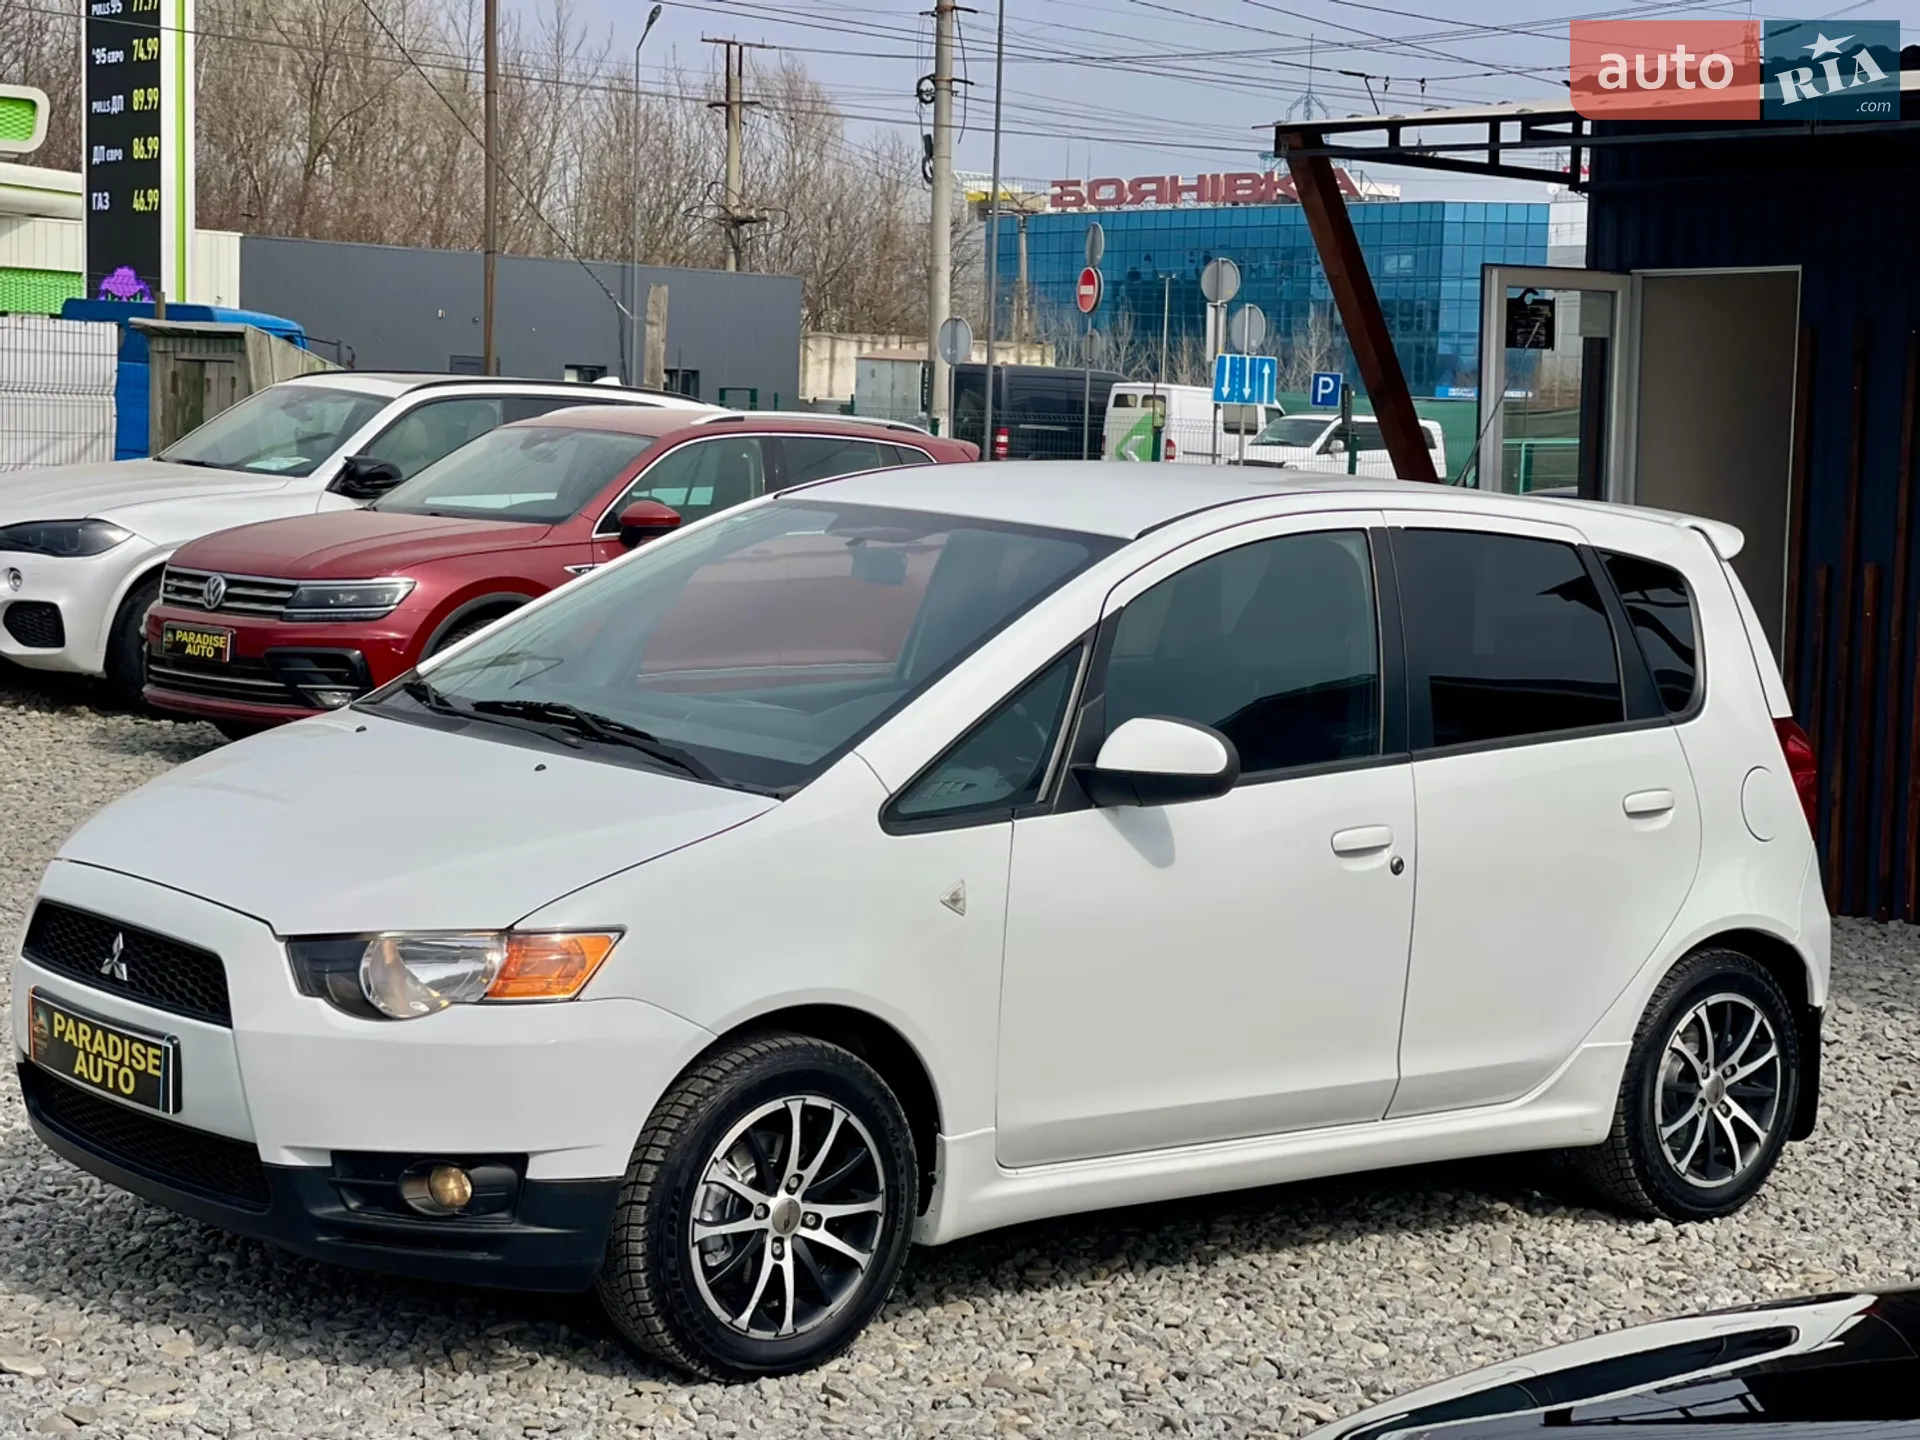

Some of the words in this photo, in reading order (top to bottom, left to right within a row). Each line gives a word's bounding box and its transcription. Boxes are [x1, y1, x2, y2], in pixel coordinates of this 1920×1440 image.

[132, 37, 158, 61] 74.99
[133, 88, 158, 111] 89.99
[92, 145, 105, 164] ДП
[133, 136, 158, 159] 86.99
[92, 191, 110, 210] ГАЗ
[132, 189, 158, 211] 46.99
[1317, 376, 1334, 403] P
[176, 630, 226, 648] PARADISE
[185, 643, 214, 658] AUTO
[53, 1011, 162, 1077] PARADISE
[74, 1050, 136, 1095] AUTO
